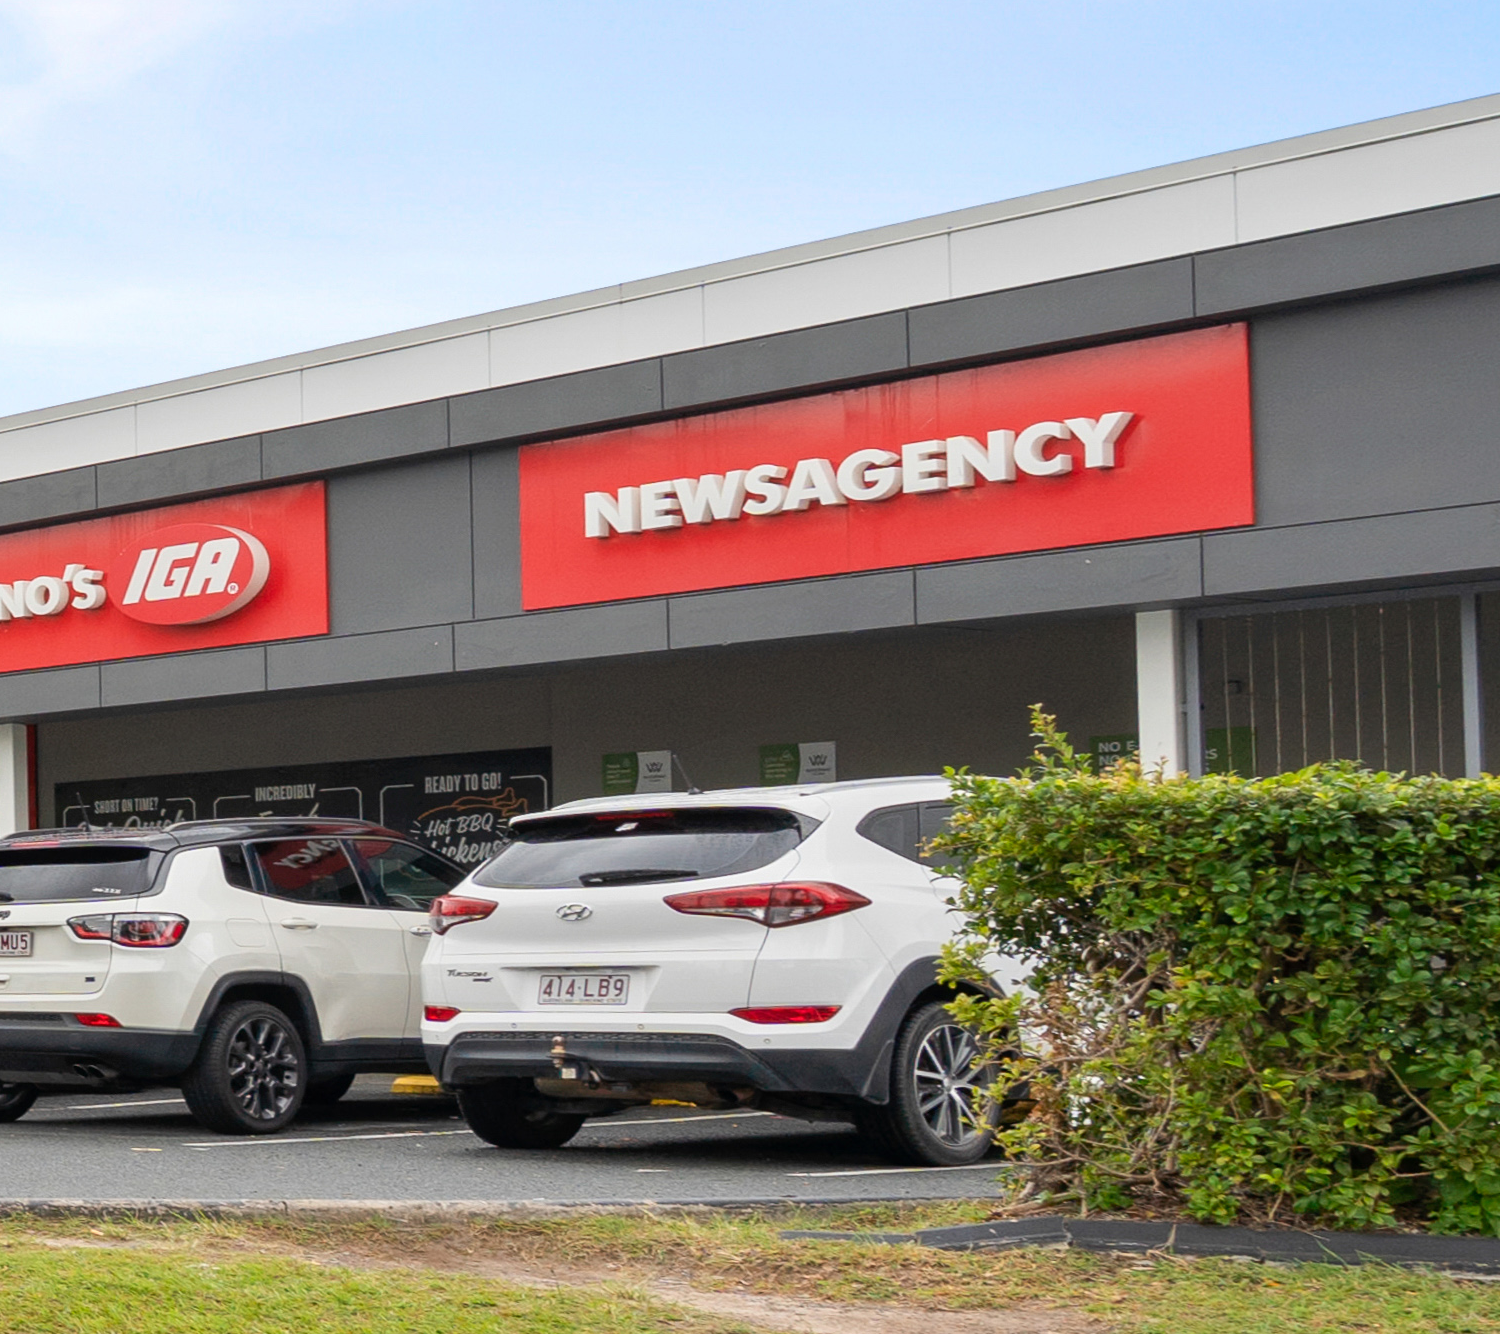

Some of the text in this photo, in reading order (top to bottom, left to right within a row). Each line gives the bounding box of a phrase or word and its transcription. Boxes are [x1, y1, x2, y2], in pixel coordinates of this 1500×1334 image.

[583, 411, 1134, 538] NEWSAGENCY
[122, 537, 241, 605] IGA
[1098, 741, 1121, 753] NO
[255, 784, 317, 802] INCREDIBLY
[425, 772, 502, 794] READY TO GO!
[94, 797, 159, 814] SHORT ON TIME?
[424, 812, 494, 837] Hot BBQ
